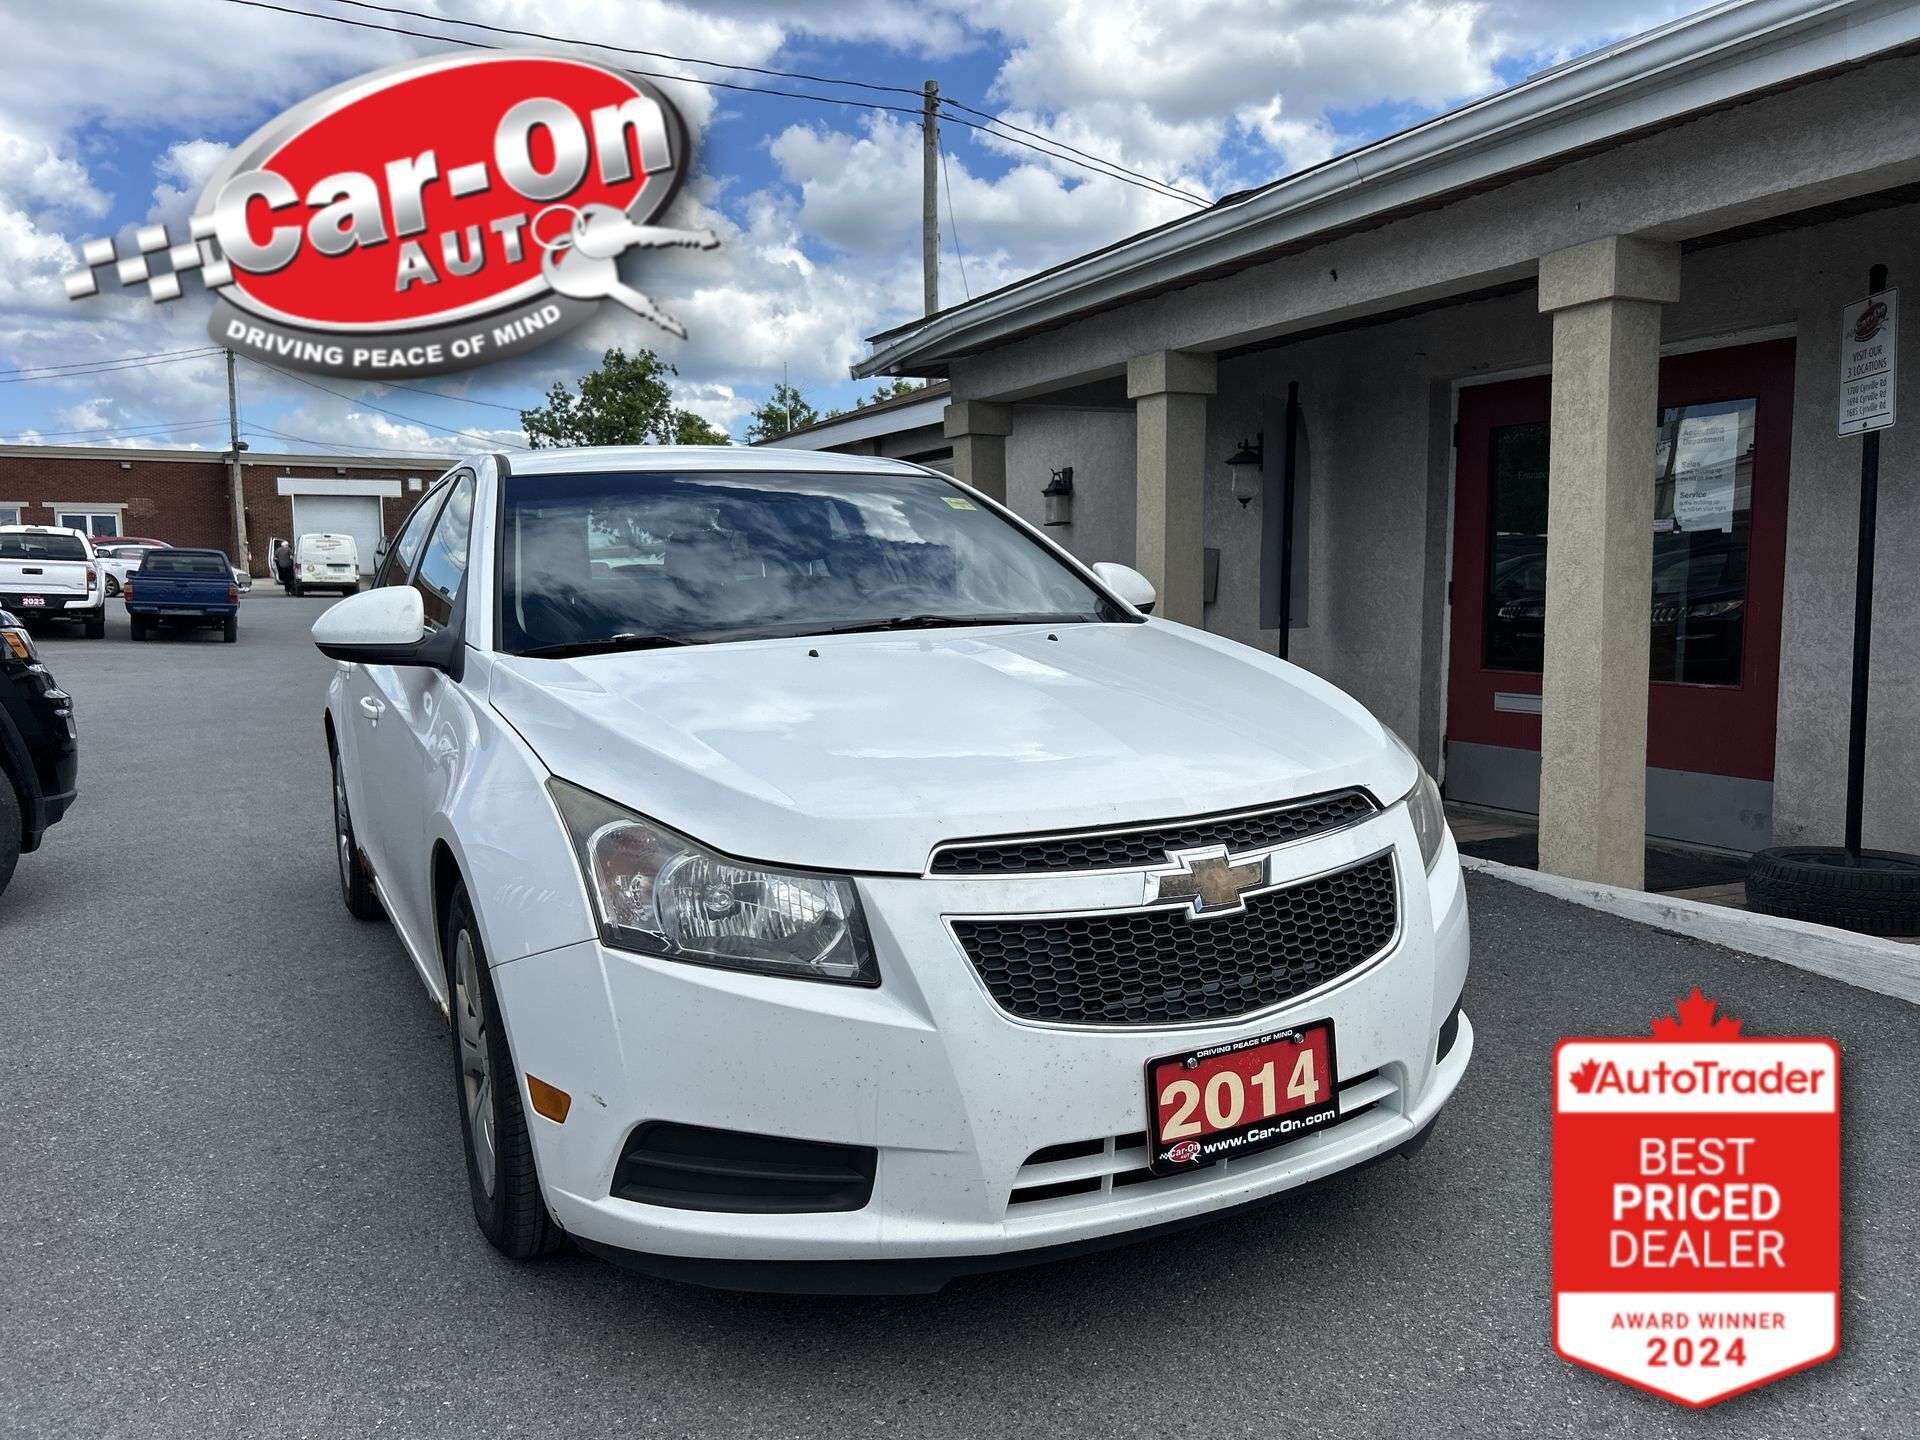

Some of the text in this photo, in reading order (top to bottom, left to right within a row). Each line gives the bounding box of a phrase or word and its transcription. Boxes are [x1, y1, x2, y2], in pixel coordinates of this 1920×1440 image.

[1853, 345, 1883, 362] VISIT OUR
[1847, 357, 1887, 379] 3 LOCATIONS
[1679, 491, 1707, 499] Service
[1197, 1029, 1293, 1058] DRIVING PEACE OF MIND
[1160, 1048, 1319, 1141] 2014
[1203, 1109, 1336, 1154] www.Car-On.com
[1170, 1143, 1200, 1158] Car-On
